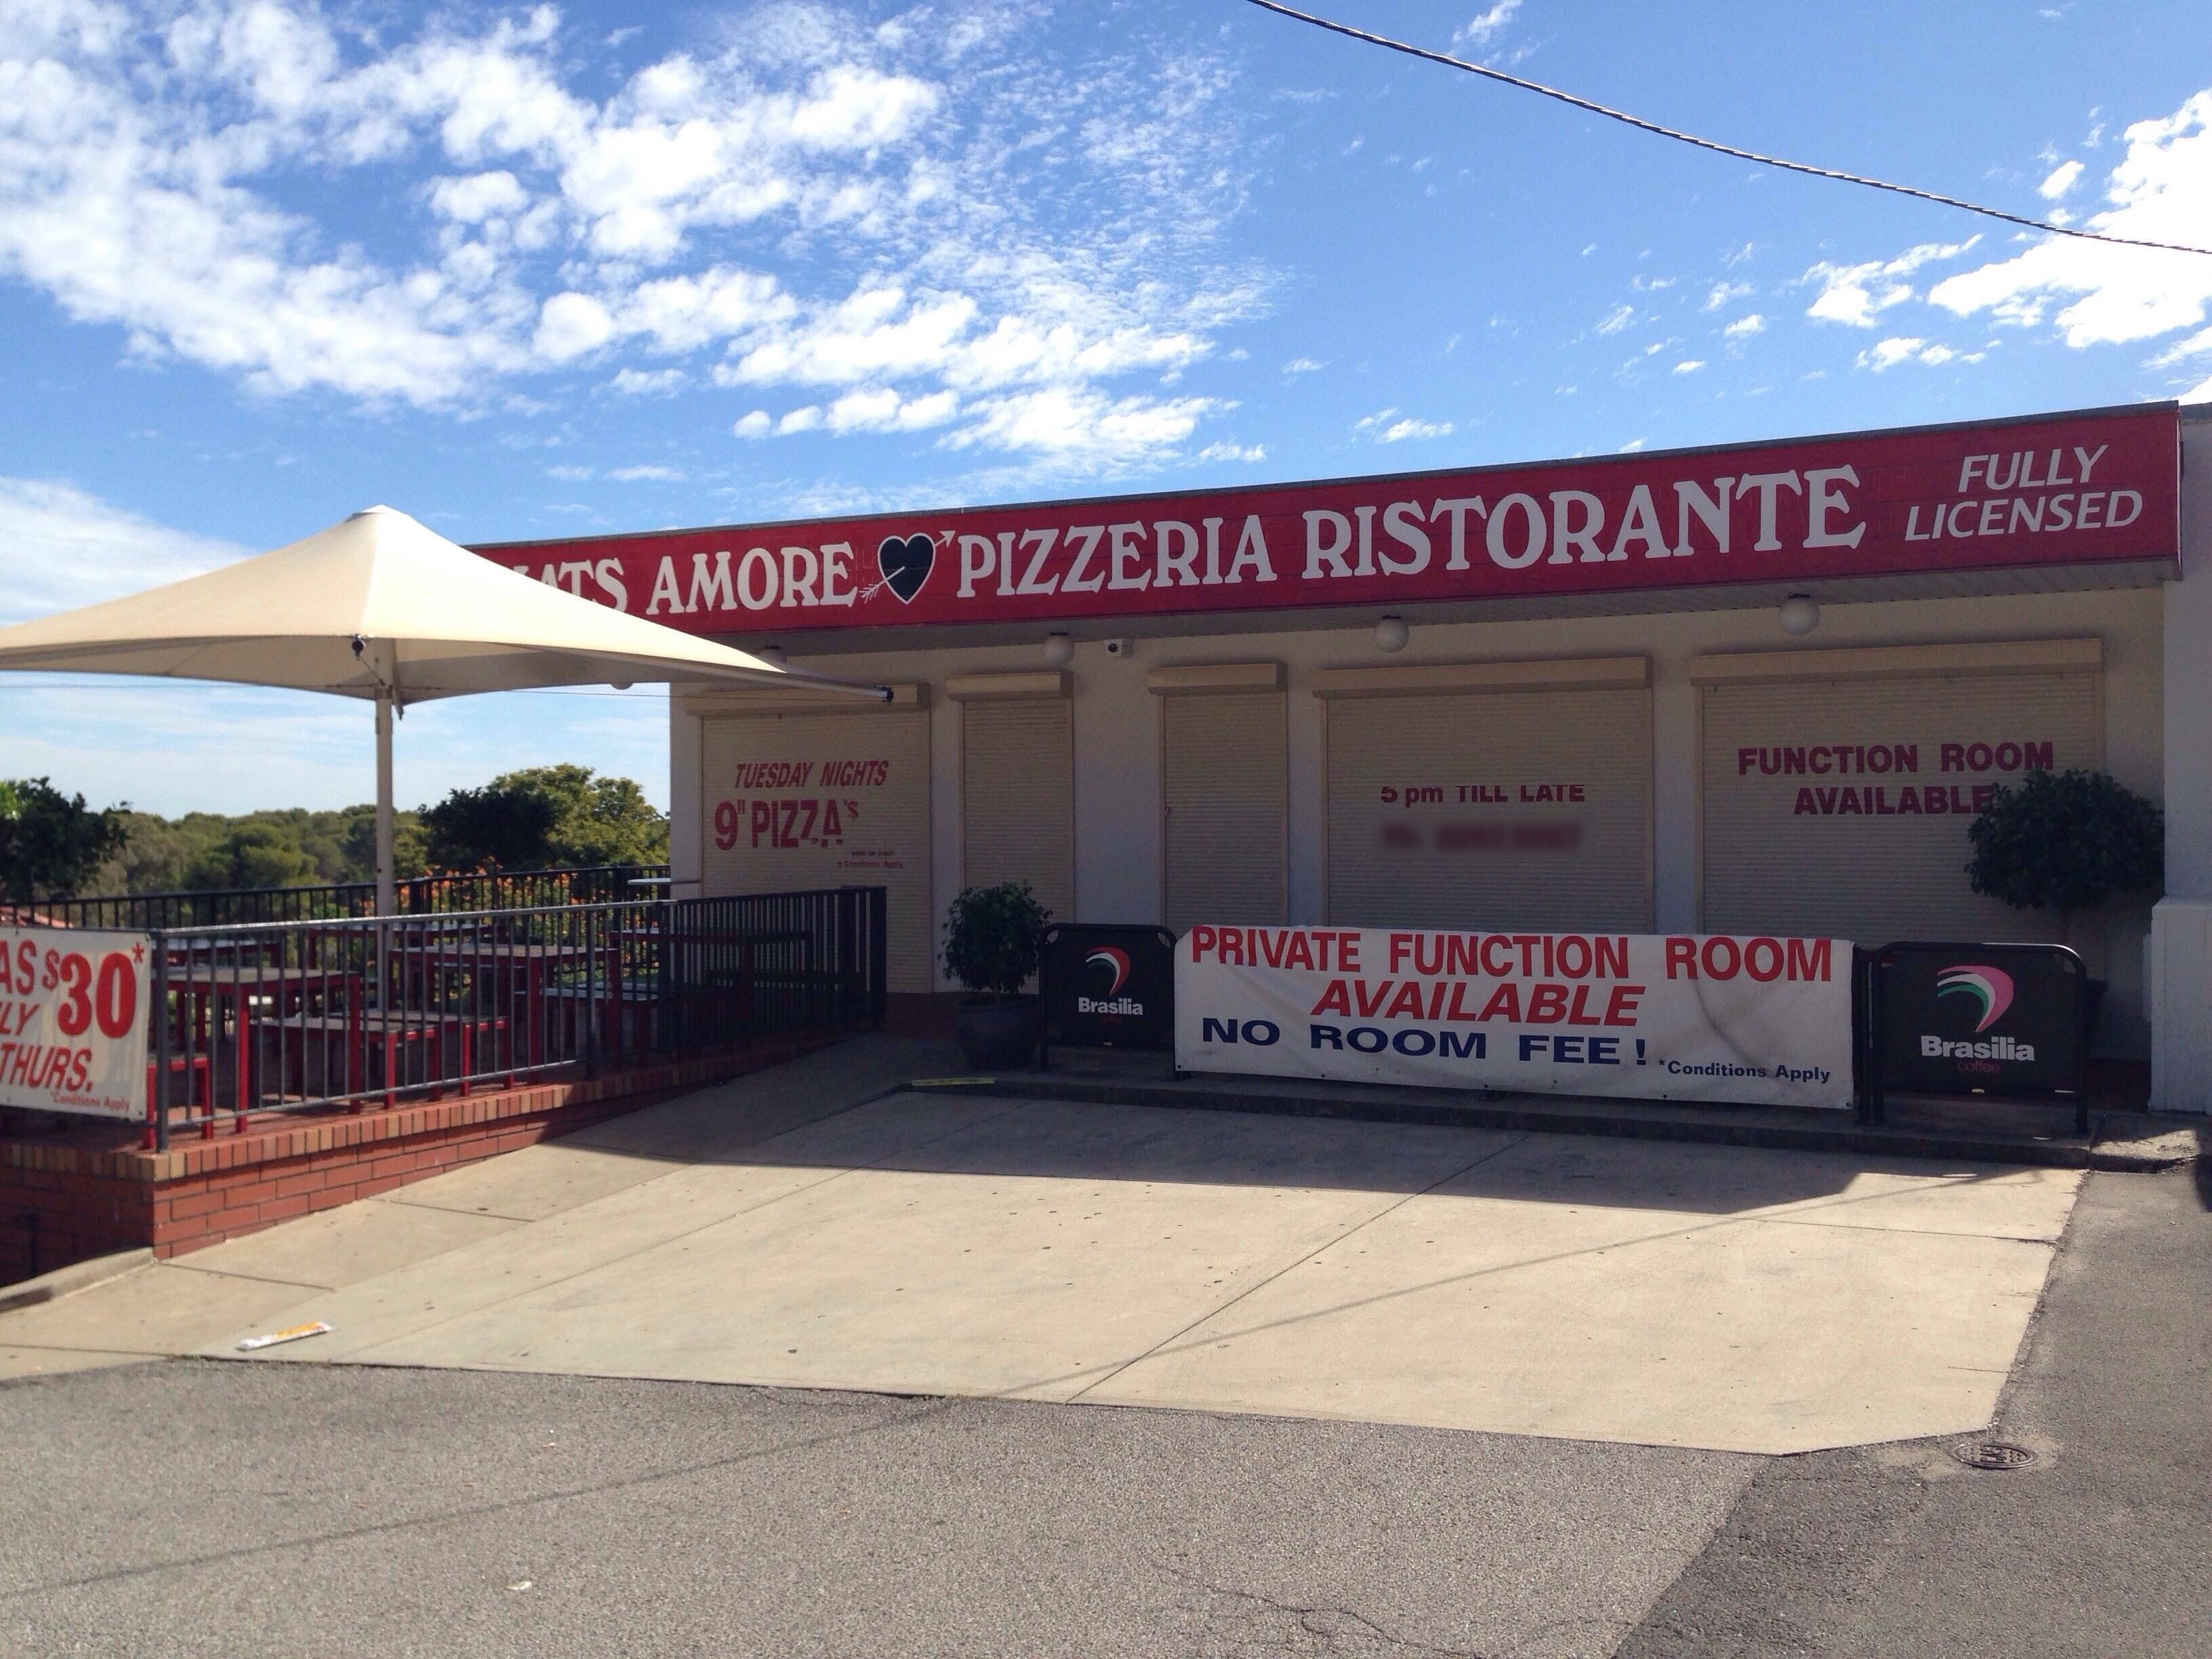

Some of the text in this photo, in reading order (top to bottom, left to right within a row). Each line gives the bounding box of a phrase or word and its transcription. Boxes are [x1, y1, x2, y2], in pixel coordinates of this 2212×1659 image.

[1958, 445, 2108, 493] FULLY
[1904, 490, 2143, 541] LICENSED
[646, 541, 857, 615] AMORE
[956, 514, 1277, 598] PIZZERIA
[1301, 464, 1866, 579] RISTORANTE
[1738, 741, 2054, 775] FUNCTION ROOM
[734, 760, 889, 789] TUESDAY NIGHTS
[1380, 784, 1585, 807] 5 pm TILL LATE
[1794, 785, 1994, 815] AVAILABLE
[1192, 926, 1832, 982] PRIVATE FUNCTION ROOM
[1078, 997, 1143, 1015] Brasilia
[1310, 980, 1646, 1027] AVAILABLE
[1202, 1017, 1280, 1046] NO
[1310, 1024, 1486, 1059] ROOM
[1921, 1036, 2035, 1061] Brasilia
[0, 1042, 92, 1092] THURS.
[1775, 1065, 1830, 1084] Apply
[1958, 1060, 2001, 1073] coffee
[103, 1095, 130, 1113] Apply
